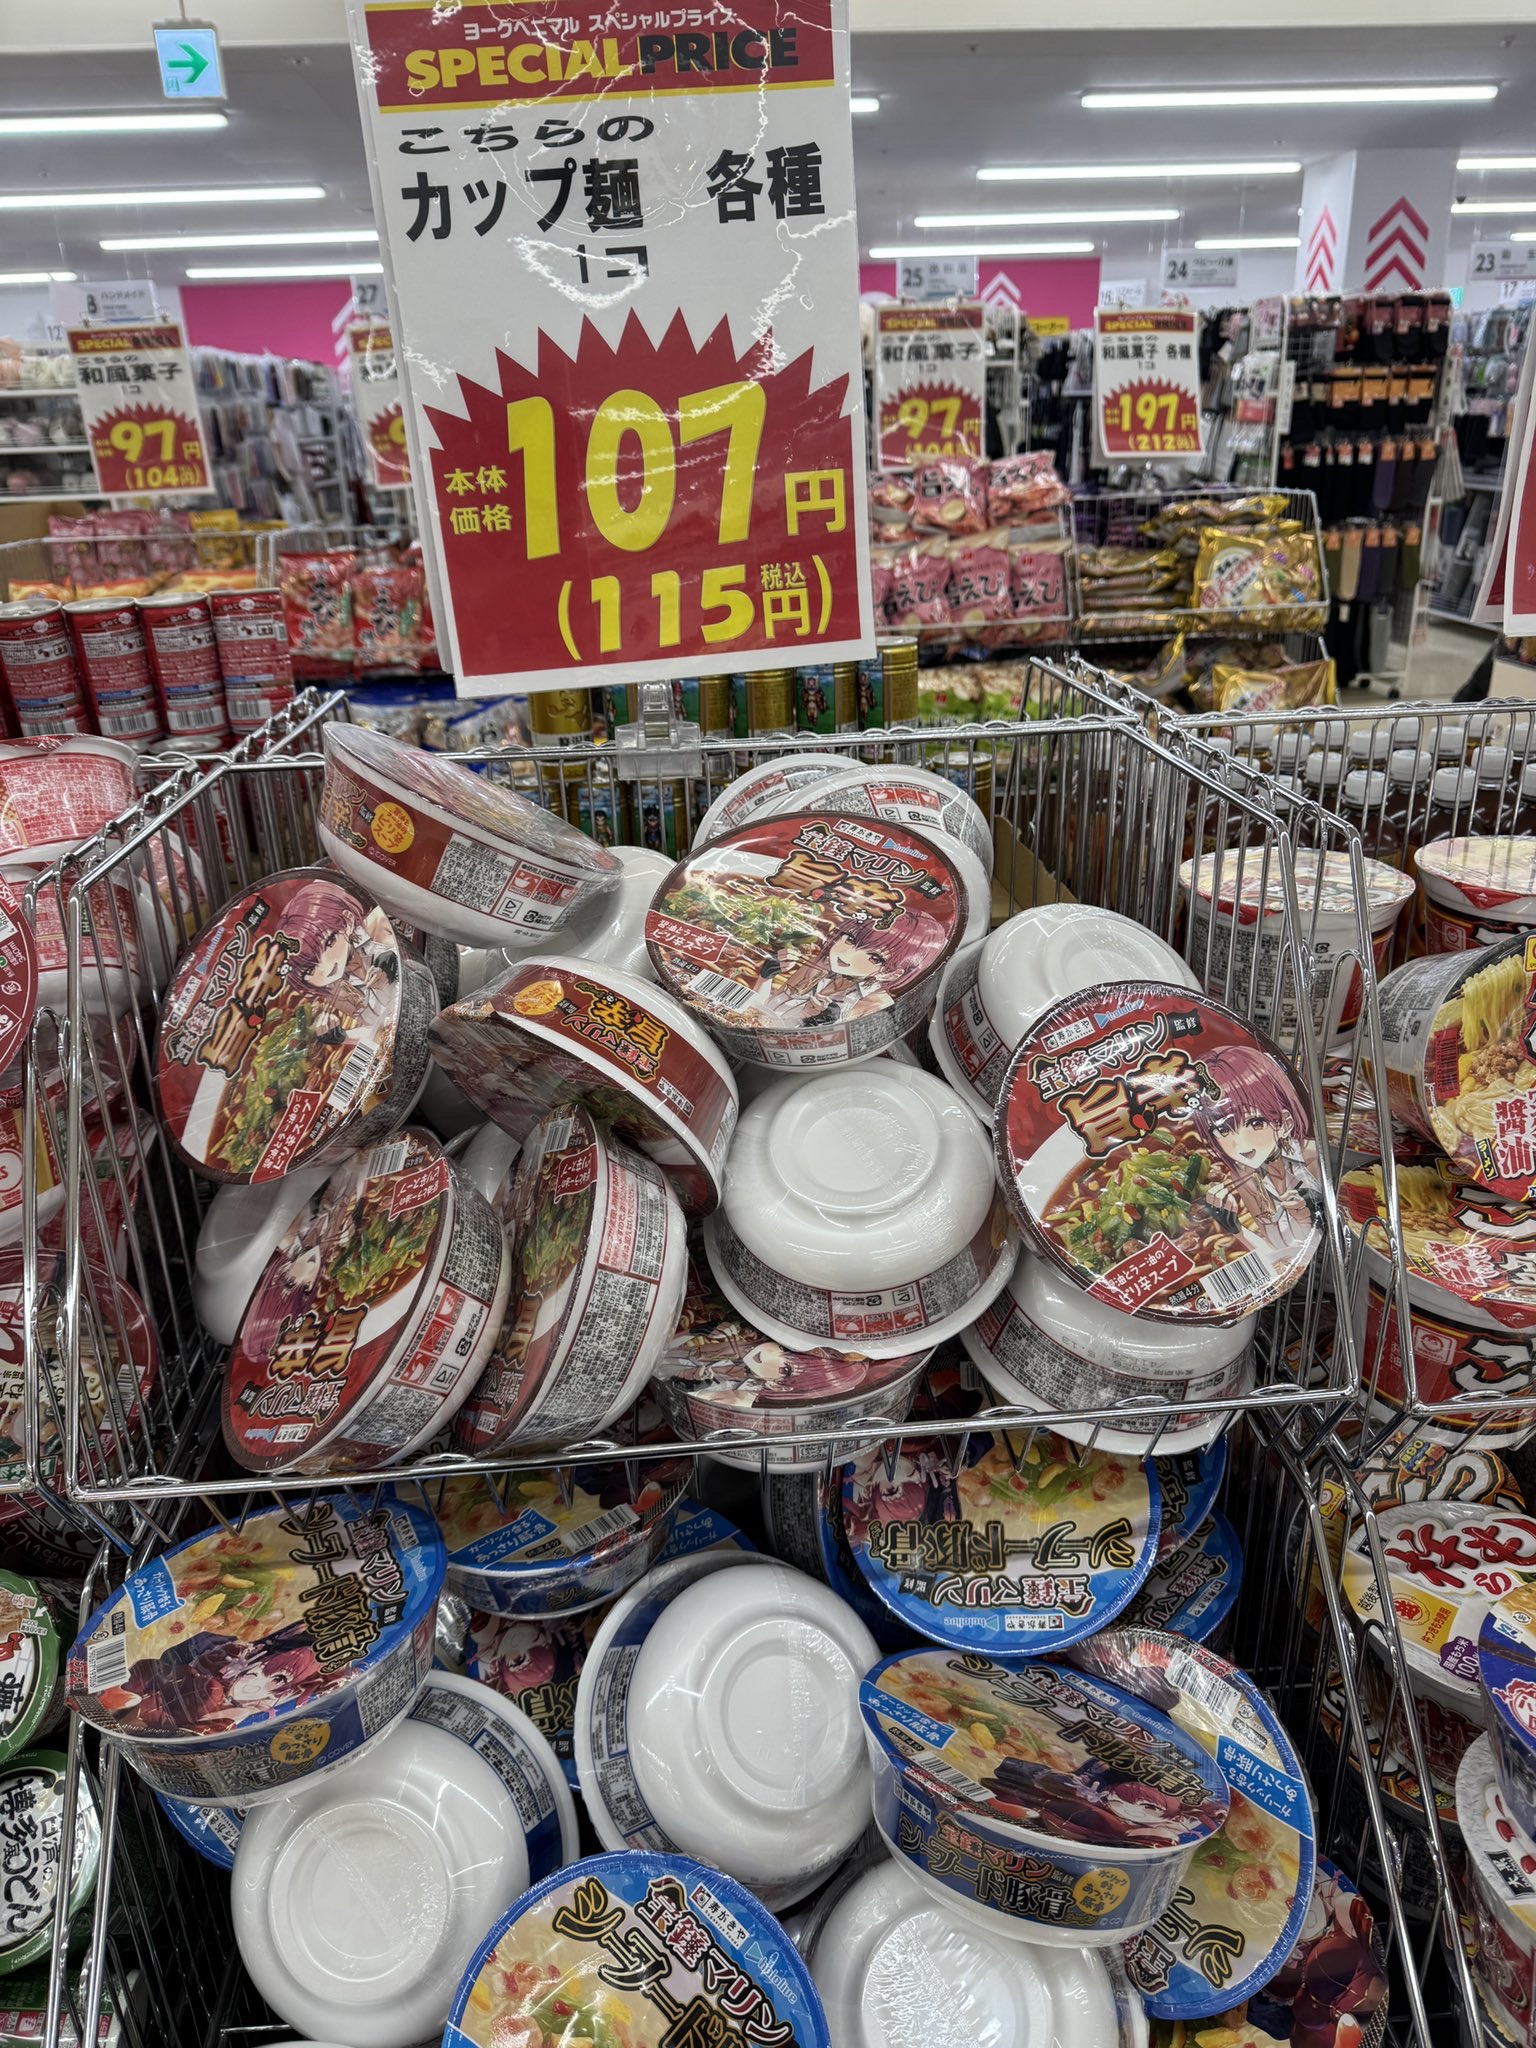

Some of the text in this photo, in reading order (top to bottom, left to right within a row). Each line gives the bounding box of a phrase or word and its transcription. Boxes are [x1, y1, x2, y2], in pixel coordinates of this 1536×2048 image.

[464, 6, 736, 41] ヨークベニマル スペシャルプライス
[404, 28, 799, 90] SPECIAL PRICE
[399, 115, 655, 155] こちらの
[401, 142, 826, 242] カップ麺 各種
[571, 243, 649, 284] 1コ
[1475, 252, 1495, 271] 23
[357, 285, 378, 303] 27
[1105, 320, 1153, 331] SPECIAL
[77, 337, 131, 351] SPECIAL
[358, 337, 391, 350] SPEC
[79, 360, 183, 386] 和風菓子
[443, 464, 508, 496] 本体
[448, 504, 513, 535] 価格
[760, 562, 807, 590] 税込
[0, 874, 18, 909] NISSI
[8, 941, 27, 965] 340ml
[1056, 1018, 1092, 1041] 寿がきや
[1174, 1015, 1199, 1033] 監修
[1478, 1139, 1498, 1180] ラーメン
[1117, 1254, 1182, 1306] ピリ辛スープ
[1167, 1283, 1201, 1307] 熱湯4分
[499, 1290, 544, 1371] 旨
[474, 1523, 548, 1563] あっさり豚骨
[881, 1519, 1136, 1571] シーフード豚骨
[1356, 1579, 1381, 1612] 越後製
[1442, 1638, 1470, 1671] 国産もち米
[327, 1739, 355, 1760] COVER
[1224, 1744, 1299, 1803] あっさり豚骨
[0, 1777, 43, 1933] 博多風うどん
[1081, 1881, 1119, 1901] あっさり
[707, 1899, 748, 1941] 寿がきや
[760, 1950, 797, 2006] hololive
